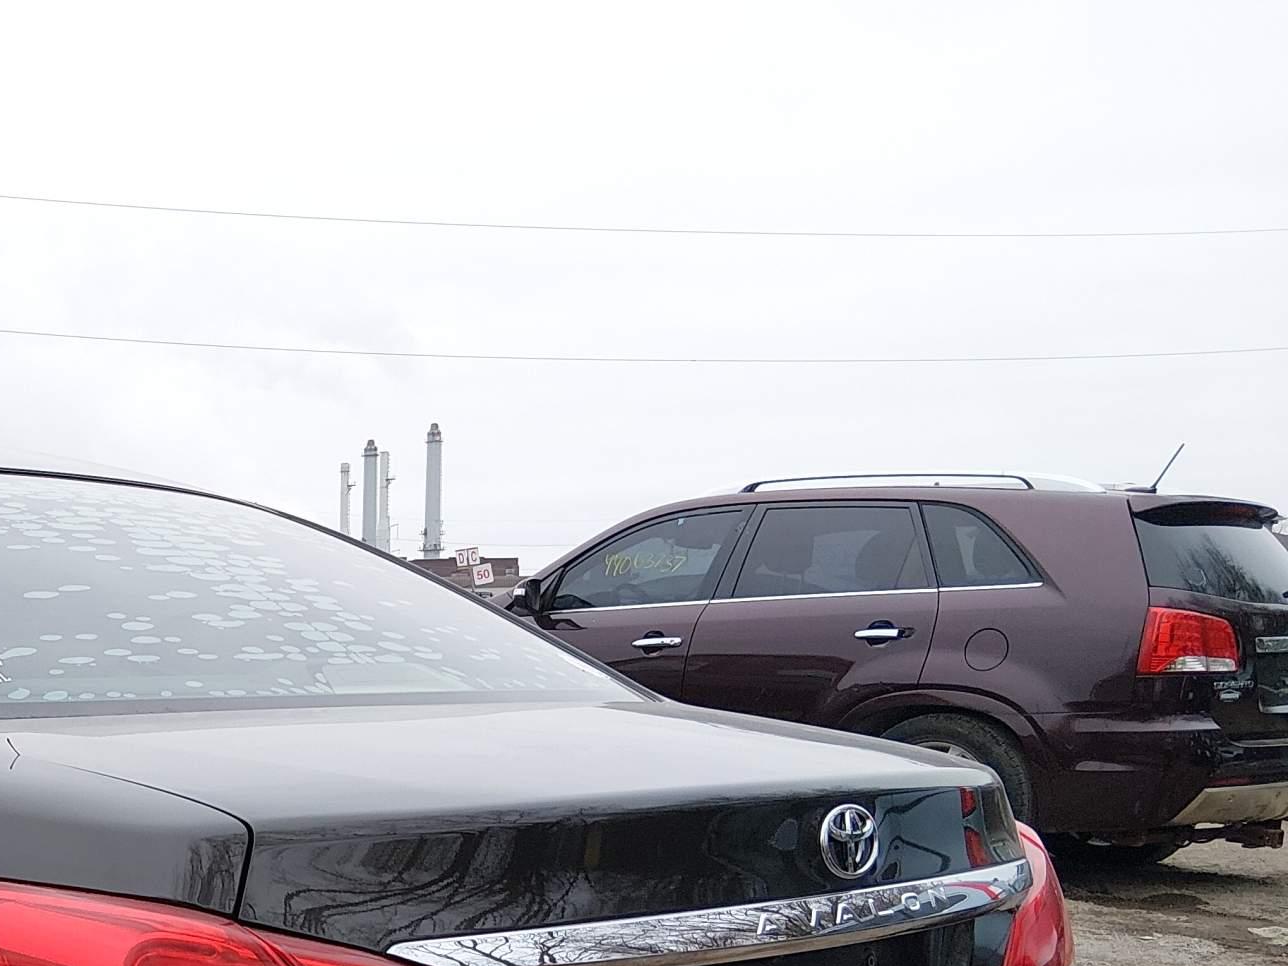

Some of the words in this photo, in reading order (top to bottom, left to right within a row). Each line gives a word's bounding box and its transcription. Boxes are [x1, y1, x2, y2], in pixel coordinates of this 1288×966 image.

[458, 553, 465, 564] D
[470, 551, 478, 562] C
[477, 569, 490, 580] 50
